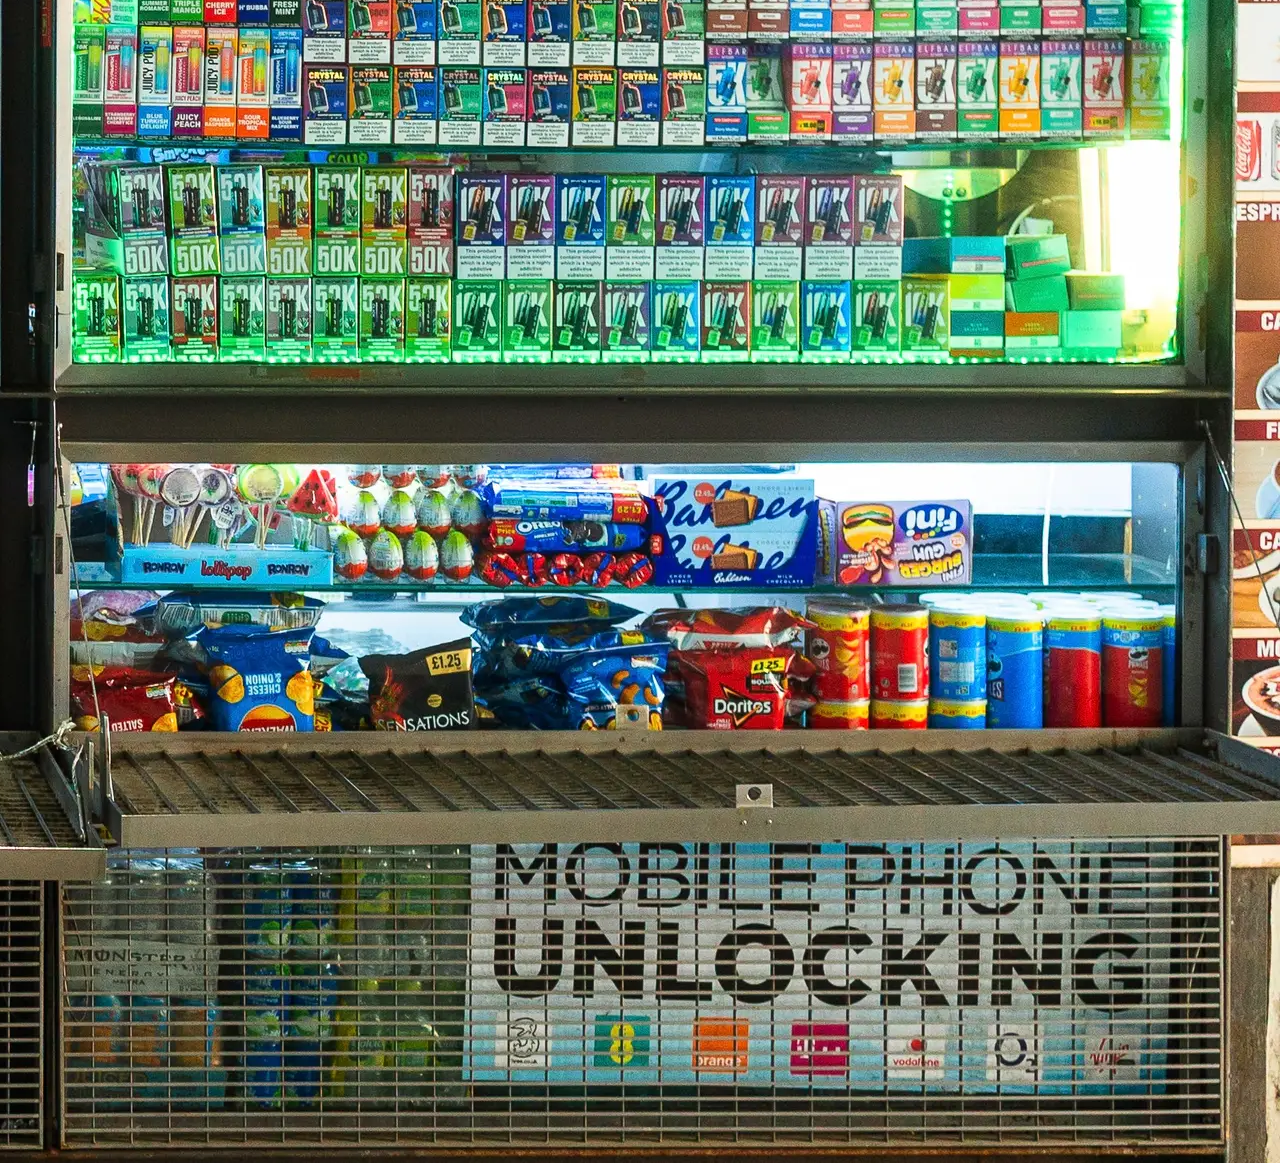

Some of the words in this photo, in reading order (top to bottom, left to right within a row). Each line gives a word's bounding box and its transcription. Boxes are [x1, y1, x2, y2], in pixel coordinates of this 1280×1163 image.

[173, 6, 201, 14] MANGO
[316, 246, 357, 272] 50K
[143, 562, 186, 575] RONRON
[200, 559, 253, 581] lollipop
[267, 563, 311, 576] RONRON
[431, 653, 461, 671] £1.25
[714, 697, 771, 716] Doritos
[495, 841, 820, 912] MOBILE
[847, 844, 1144, 917] PHONE
[493, 919, 1144, 1013] UNLOCKING
